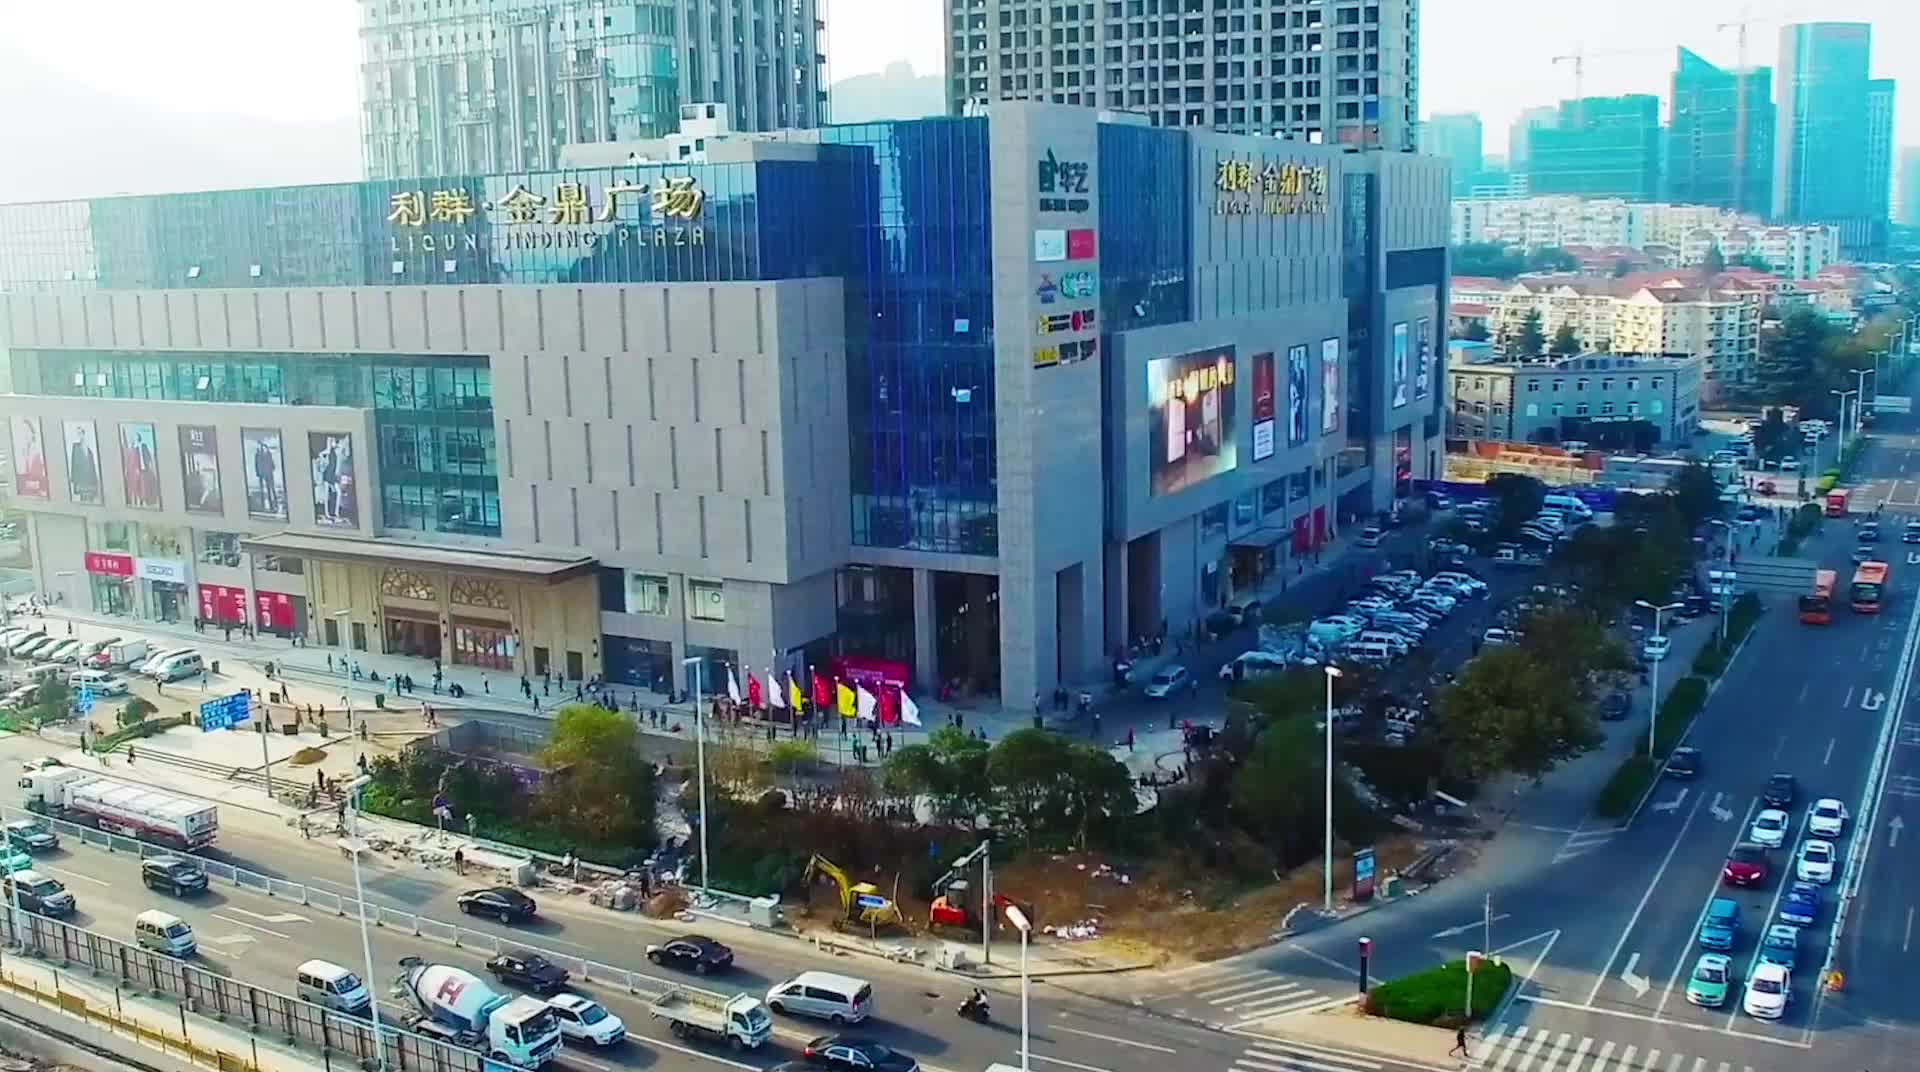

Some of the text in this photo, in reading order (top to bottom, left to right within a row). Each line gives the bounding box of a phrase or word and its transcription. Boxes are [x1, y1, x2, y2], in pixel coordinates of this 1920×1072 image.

[391, 226, 706, 252] LIQUN JINDING PLAZA
